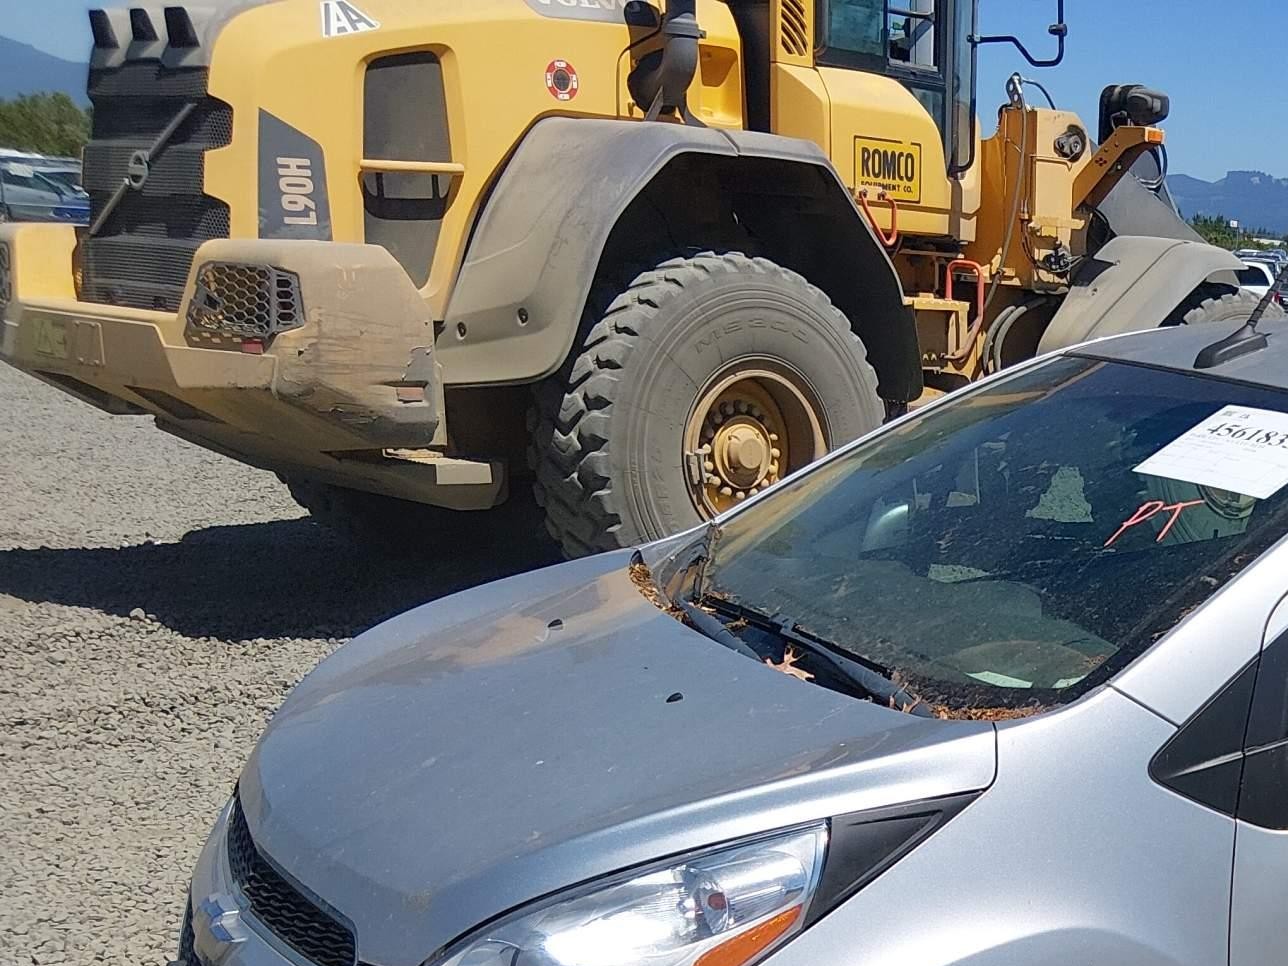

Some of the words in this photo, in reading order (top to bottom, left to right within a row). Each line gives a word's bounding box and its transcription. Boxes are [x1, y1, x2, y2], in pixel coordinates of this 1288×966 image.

[861, 147, 915, 182] ROMCO
[276, 156, 318, 225] L90H
[903, 185, 914, 194] CO.
[1103, 499, 1205, 548] PT
